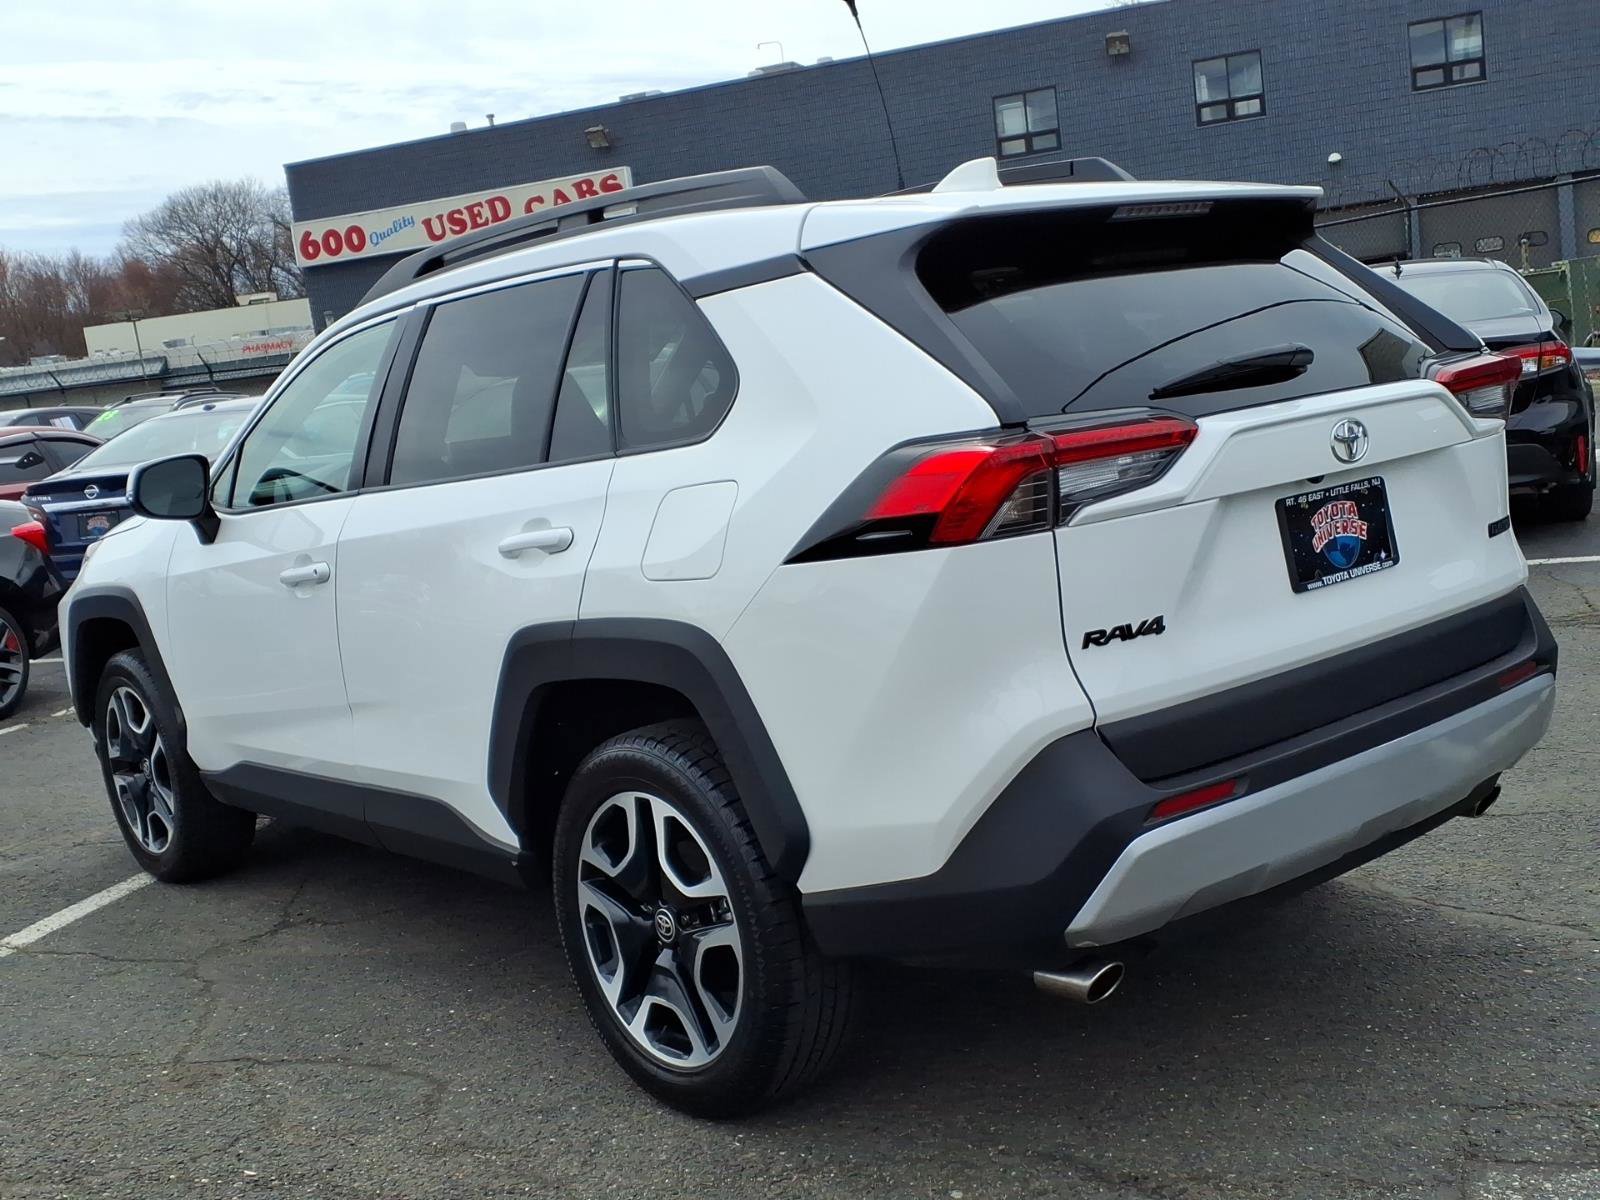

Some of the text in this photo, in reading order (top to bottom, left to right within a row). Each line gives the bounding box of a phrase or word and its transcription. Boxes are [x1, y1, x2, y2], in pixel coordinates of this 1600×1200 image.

[300, 173, 624, 260] 600 Quality USED CARS
[242, 340, 293, 352] PHARMACY
[1308, 491, 1325, 502] EAST
[1330, 485, 1350, 496] LITTLE
[1371, 477, 1381, 487] NJ
[1311, 500, 1359, 531] TOYOTA
[1312, 519, 1368, 553] UNIVERSE
[1081, 614, 1166, 650] RAV4
